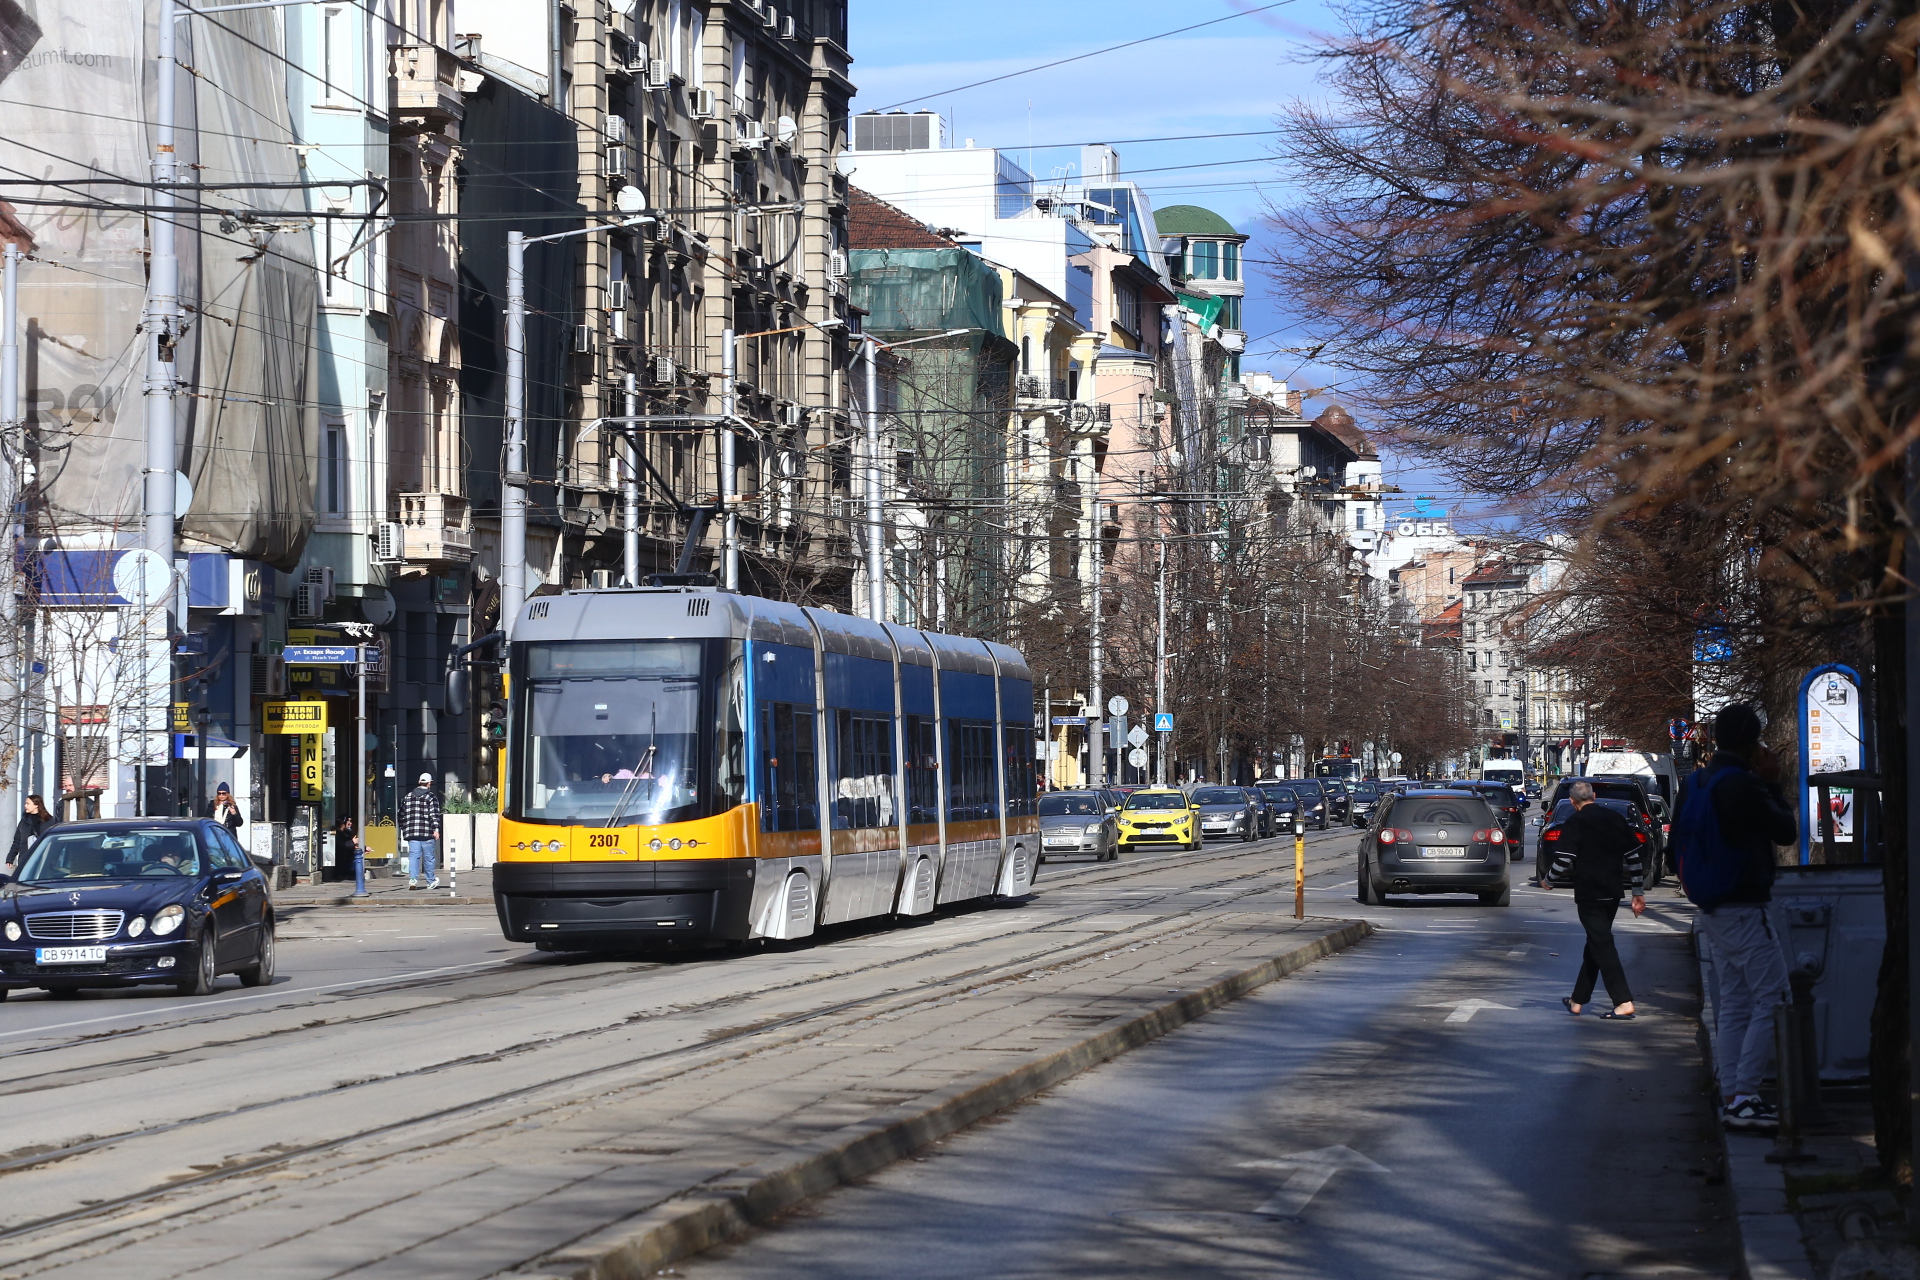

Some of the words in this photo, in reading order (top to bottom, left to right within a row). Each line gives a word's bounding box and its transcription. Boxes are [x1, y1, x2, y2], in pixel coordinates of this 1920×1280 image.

[1397, 522, 1448, 536] ОББ
[268, 706, 313, 714] WESTERN
[589, 834, 620, 847] 2307
[43, 949, 58, 961] CB
[60, 948, 87, 960] 9914
[89, 948, 103, 959] TC
